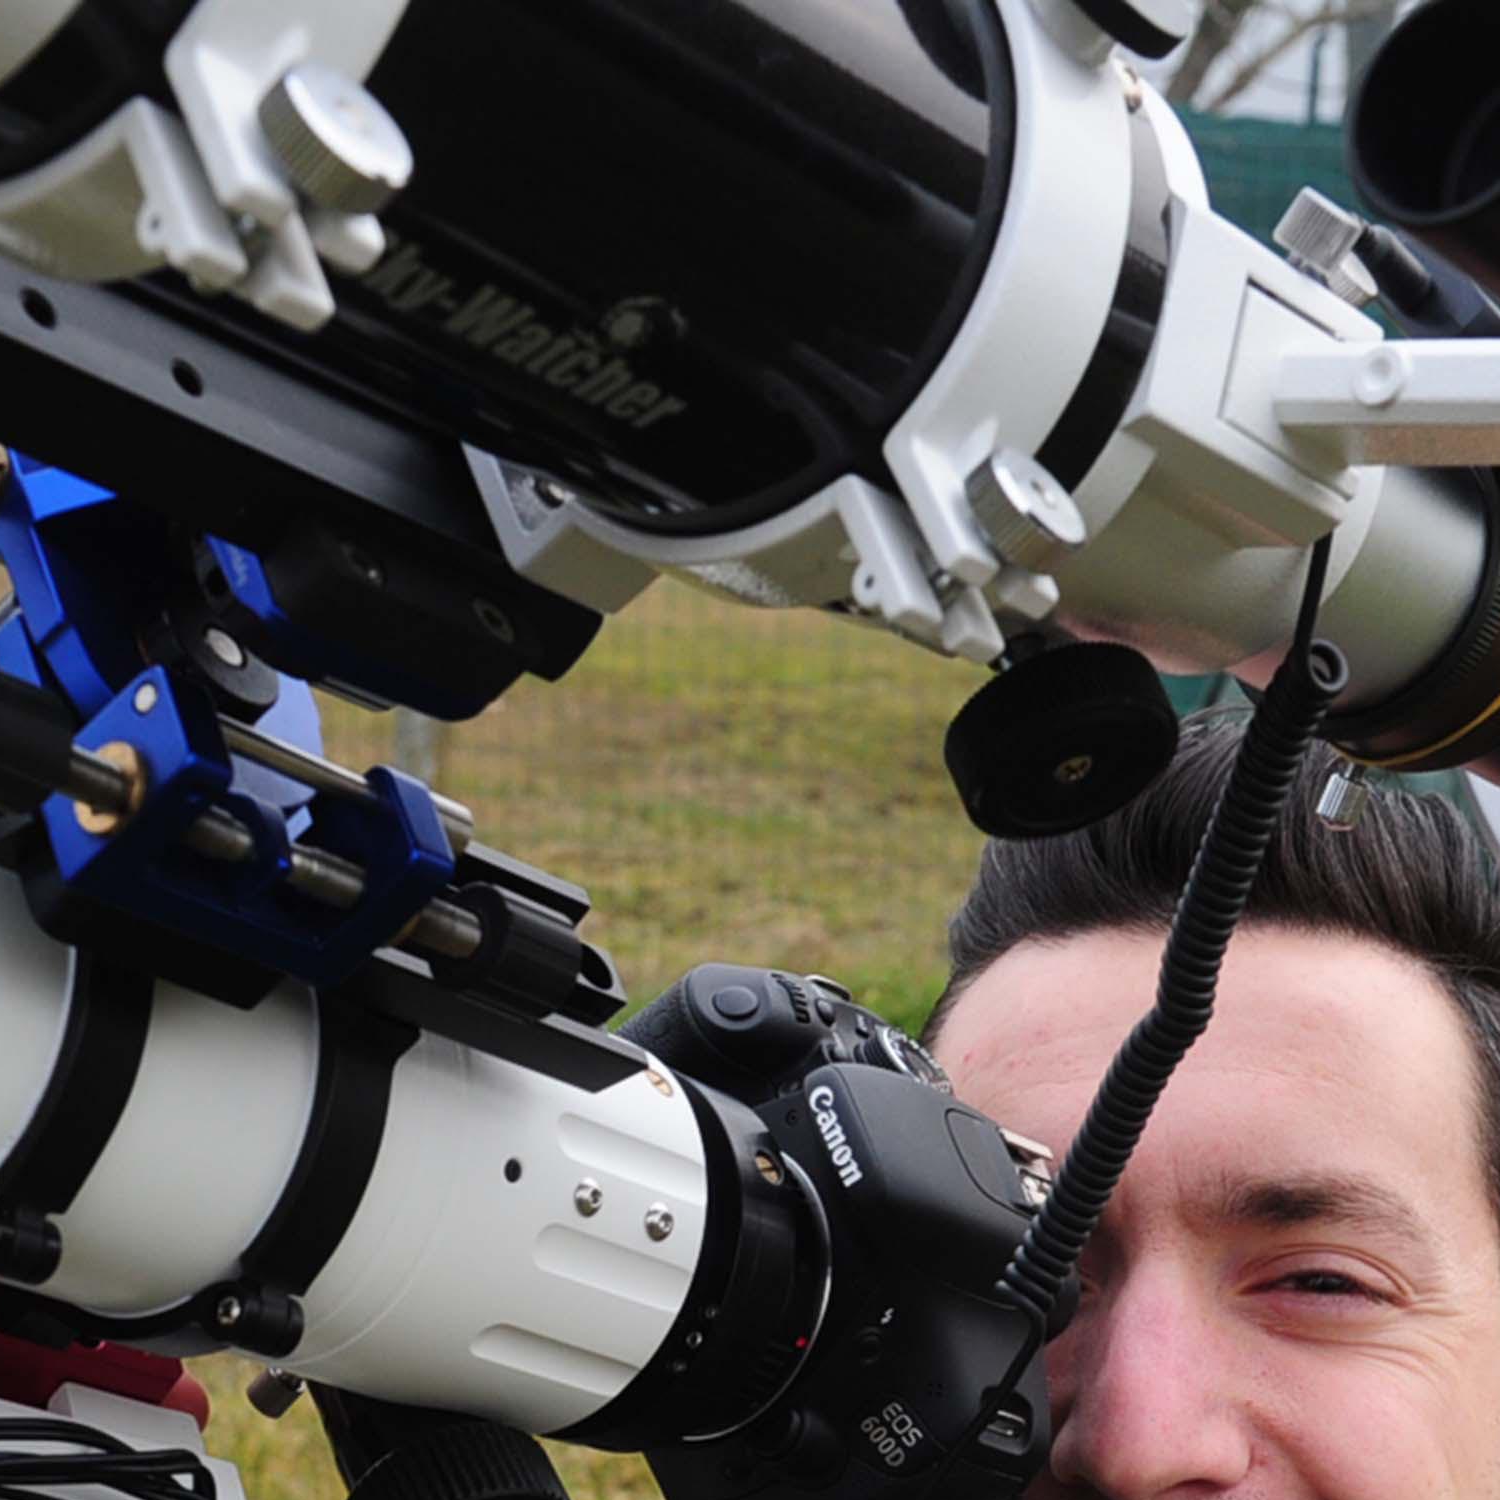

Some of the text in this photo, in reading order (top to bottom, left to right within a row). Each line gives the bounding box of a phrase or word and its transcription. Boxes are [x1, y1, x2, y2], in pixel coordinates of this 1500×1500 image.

[357, 228, 689, 430] ky-Watcher
[808, 1085, 864, 1189] Canon
[860, 1415, 906, 1468] 600D
[882, 1402, 924, 1448] EOS
